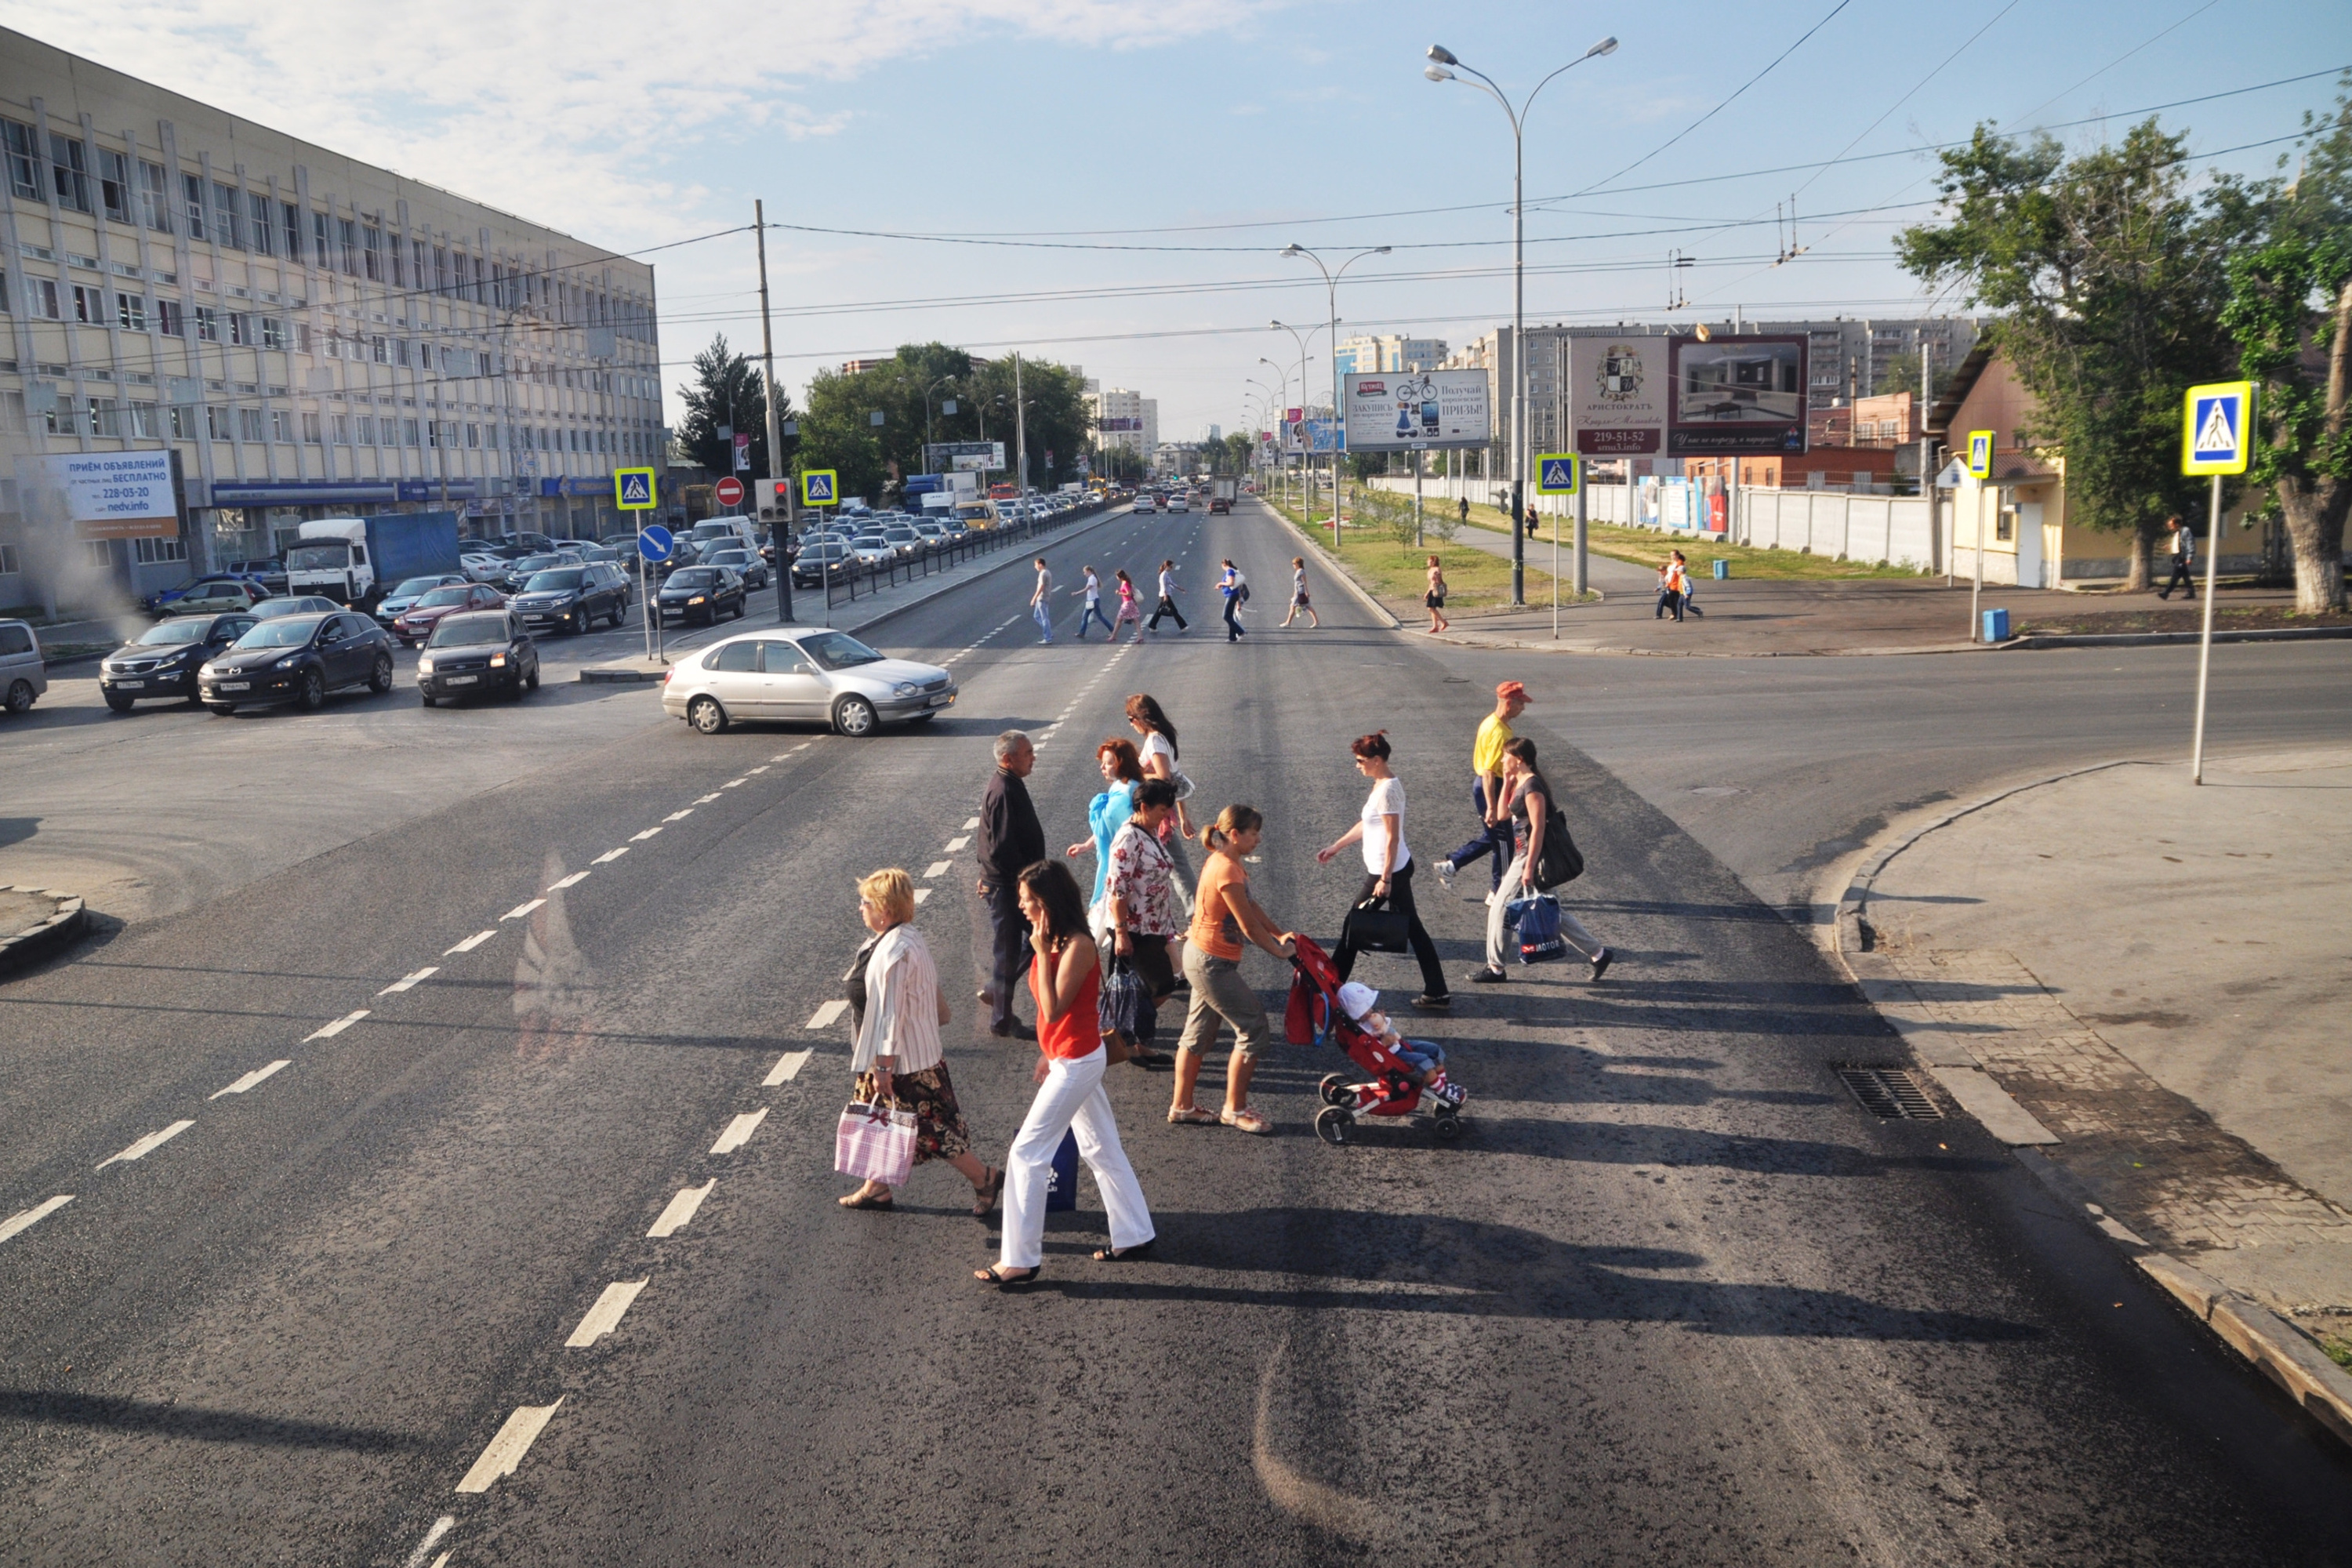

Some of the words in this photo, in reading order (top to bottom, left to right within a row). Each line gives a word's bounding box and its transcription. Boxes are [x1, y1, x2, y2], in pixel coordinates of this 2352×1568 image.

[1442, 385, 1481, 397] Получай
[1352, 403, 1393, 412] ЗАКУПИСЬ
[1443, 405, 1483, 416] ПРИЗЫ!
[1593, 431, 1645, 442] 219-51-52
[1597, 443, 1641, 452] smu3.info
[69, 461, 101, 471] ПРИЁМ
[103, 459, 165, 470] ОБЪЯВЛЕНИЙ
[112, 472, 166, 483] БЕСПЛАТНО
[103, 487, 150, 499] 228-03-20
[107, 501, 149, 511] nedv.info
